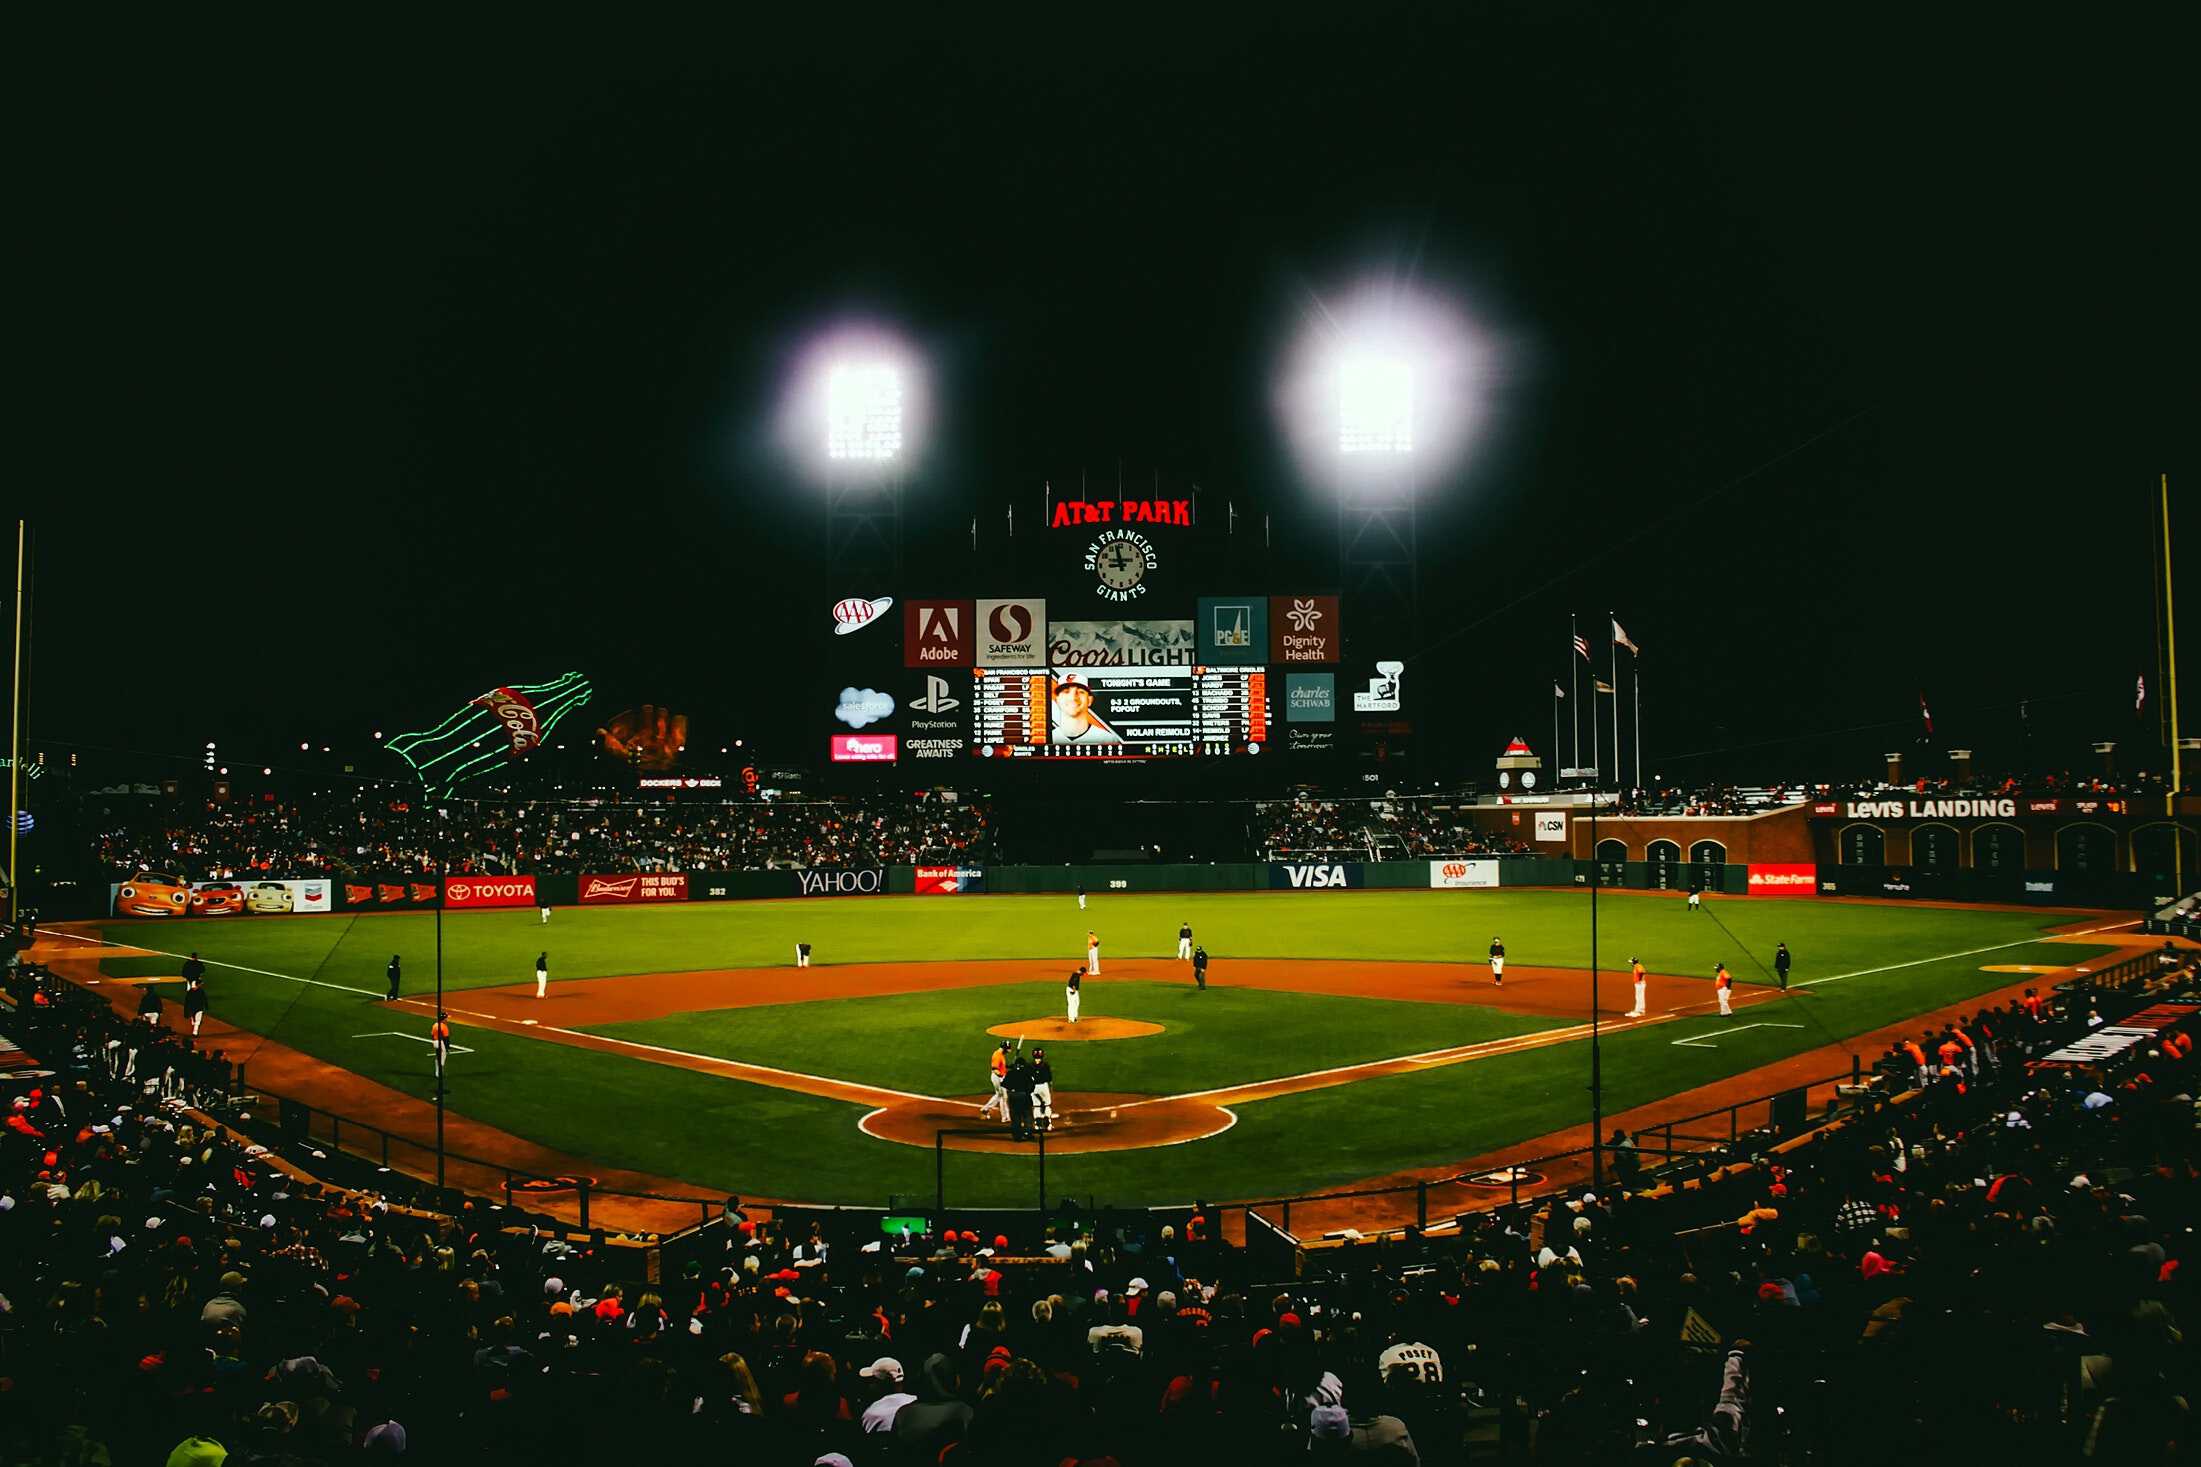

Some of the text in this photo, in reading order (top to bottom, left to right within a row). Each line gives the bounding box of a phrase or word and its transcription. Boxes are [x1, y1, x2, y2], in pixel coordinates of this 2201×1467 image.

[1052, 501, 1191, 528] AT&T PARK
[1085, 529, 1158, 571] SAN FRANCISCO
[1096, 583, 1147, 601] GIANTS
[835, 600, 873, 624] AAA
[1216, 630, 1249, 645] PG&E
[1283, 635, 1326, 649] Dignity
[920, 646, 959, 660] Adobe
[989, 644, 1032, 653] SAFEWAY
[1048, 640, 1194, 666] Coors LIGHT
[1285, 649, 1325, 660] Health
[1101, 679, 1171, 687] TONIGHT'S GAME
[1290, 686, 1330, 699] charles
[1290, 699, 1331, 708] SCHWAB
[498, 704, 539, 753] Cola
[911, 720, 957, 731] PlayStation
[1126, 728, 1191, 737] NOLAN REIMOLD
[906, 739, 964, 749] GREATNESS
[916, 749, 954, 758] AWAITS
[640, 779, 682, 787] DOCKERS
[1910, 799, 2016, 817] LANDING
[1547, 821, 1563, 831] CSN
[917, 869, 982, 878] Bank of America
[1282, 865, 1347, 888] VISA
[1442, 863, 1466, 878] AAA
[641, 877, 685, 887] THIS BUD'S
[798, 869, 883, 894] YAHOO!
[1110, 880, 1127, 888] 399
[1764, 874, 1789, 885] State
[474, 884, 534, 897] TOYOTA
[591, 880, 634, 893] Budweiser
[641, 888, 676, 897] FOR YOU.
[709, 888, 726, 896] 382
[1398, 1349, 1433, 1361] POSEY
